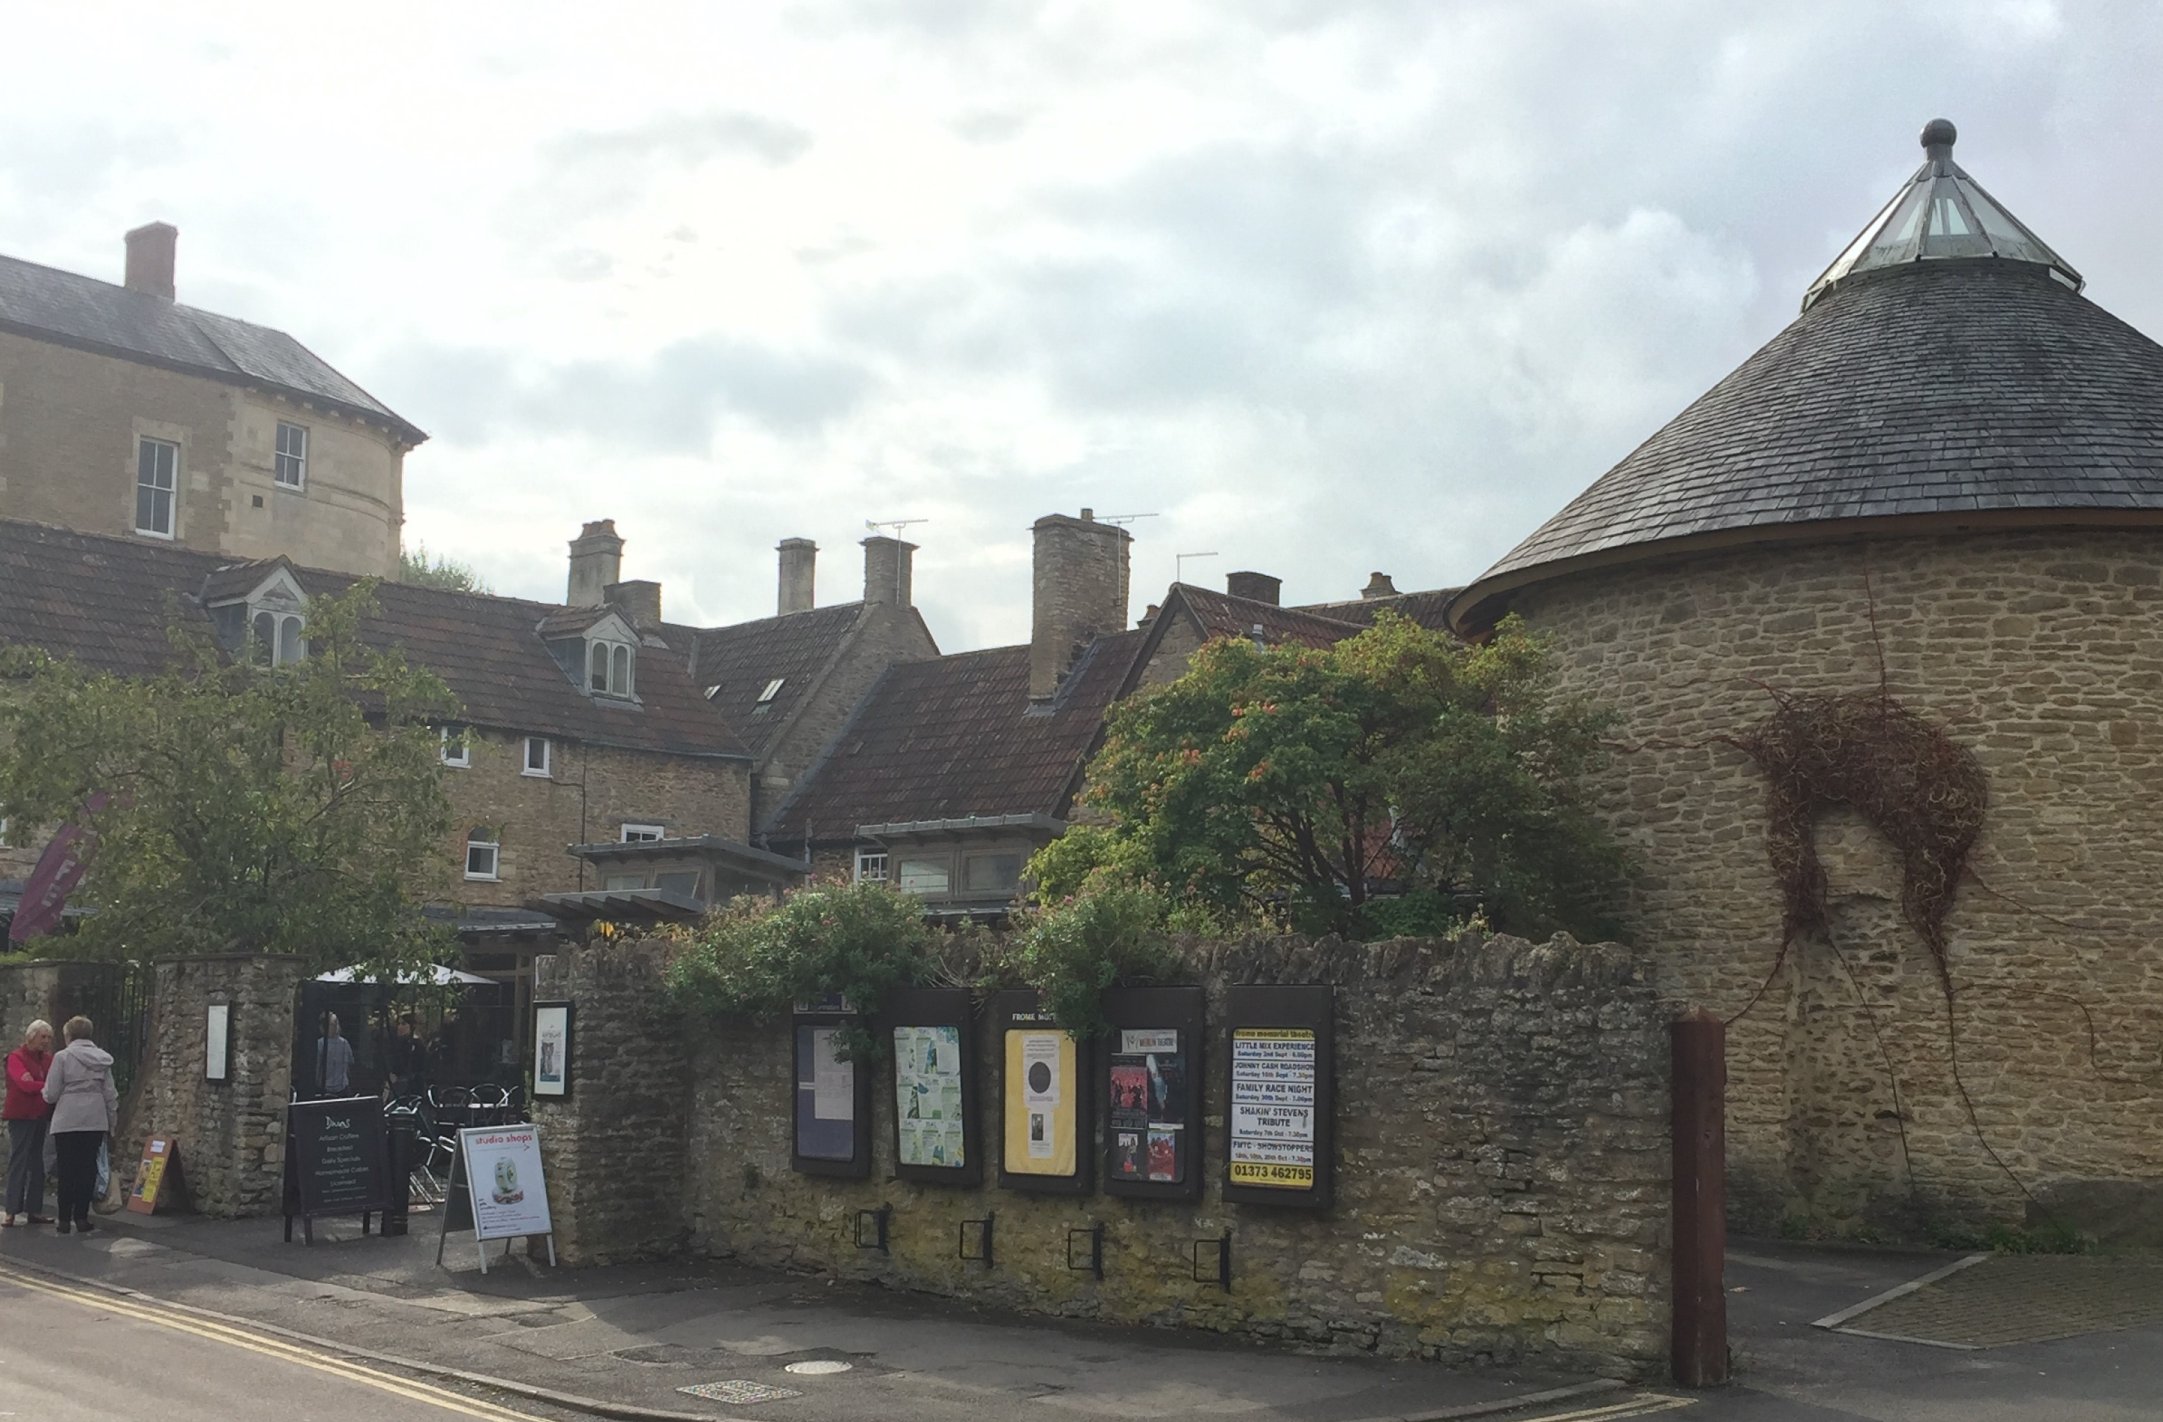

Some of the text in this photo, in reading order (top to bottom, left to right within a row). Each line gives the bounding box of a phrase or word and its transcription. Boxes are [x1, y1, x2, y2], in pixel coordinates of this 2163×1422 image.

[1235, 1042, 1257, 1050] LITTLE
[1259, 1042, 1272, 1050] MIX
[1261, 1062, 1279, 1070] CASH
[1236, 1083, 1313, 1094] FAMILY RACE NIGHT
[1240, 1106, 1308, 1117] SHAKIN' STEVENS
[1257, 1117, 1291, 1127] TRIBUTE
[475, 1133, 532, 1145] studio shops
[1234, 1165, 1312, 1180] 01373 462795
